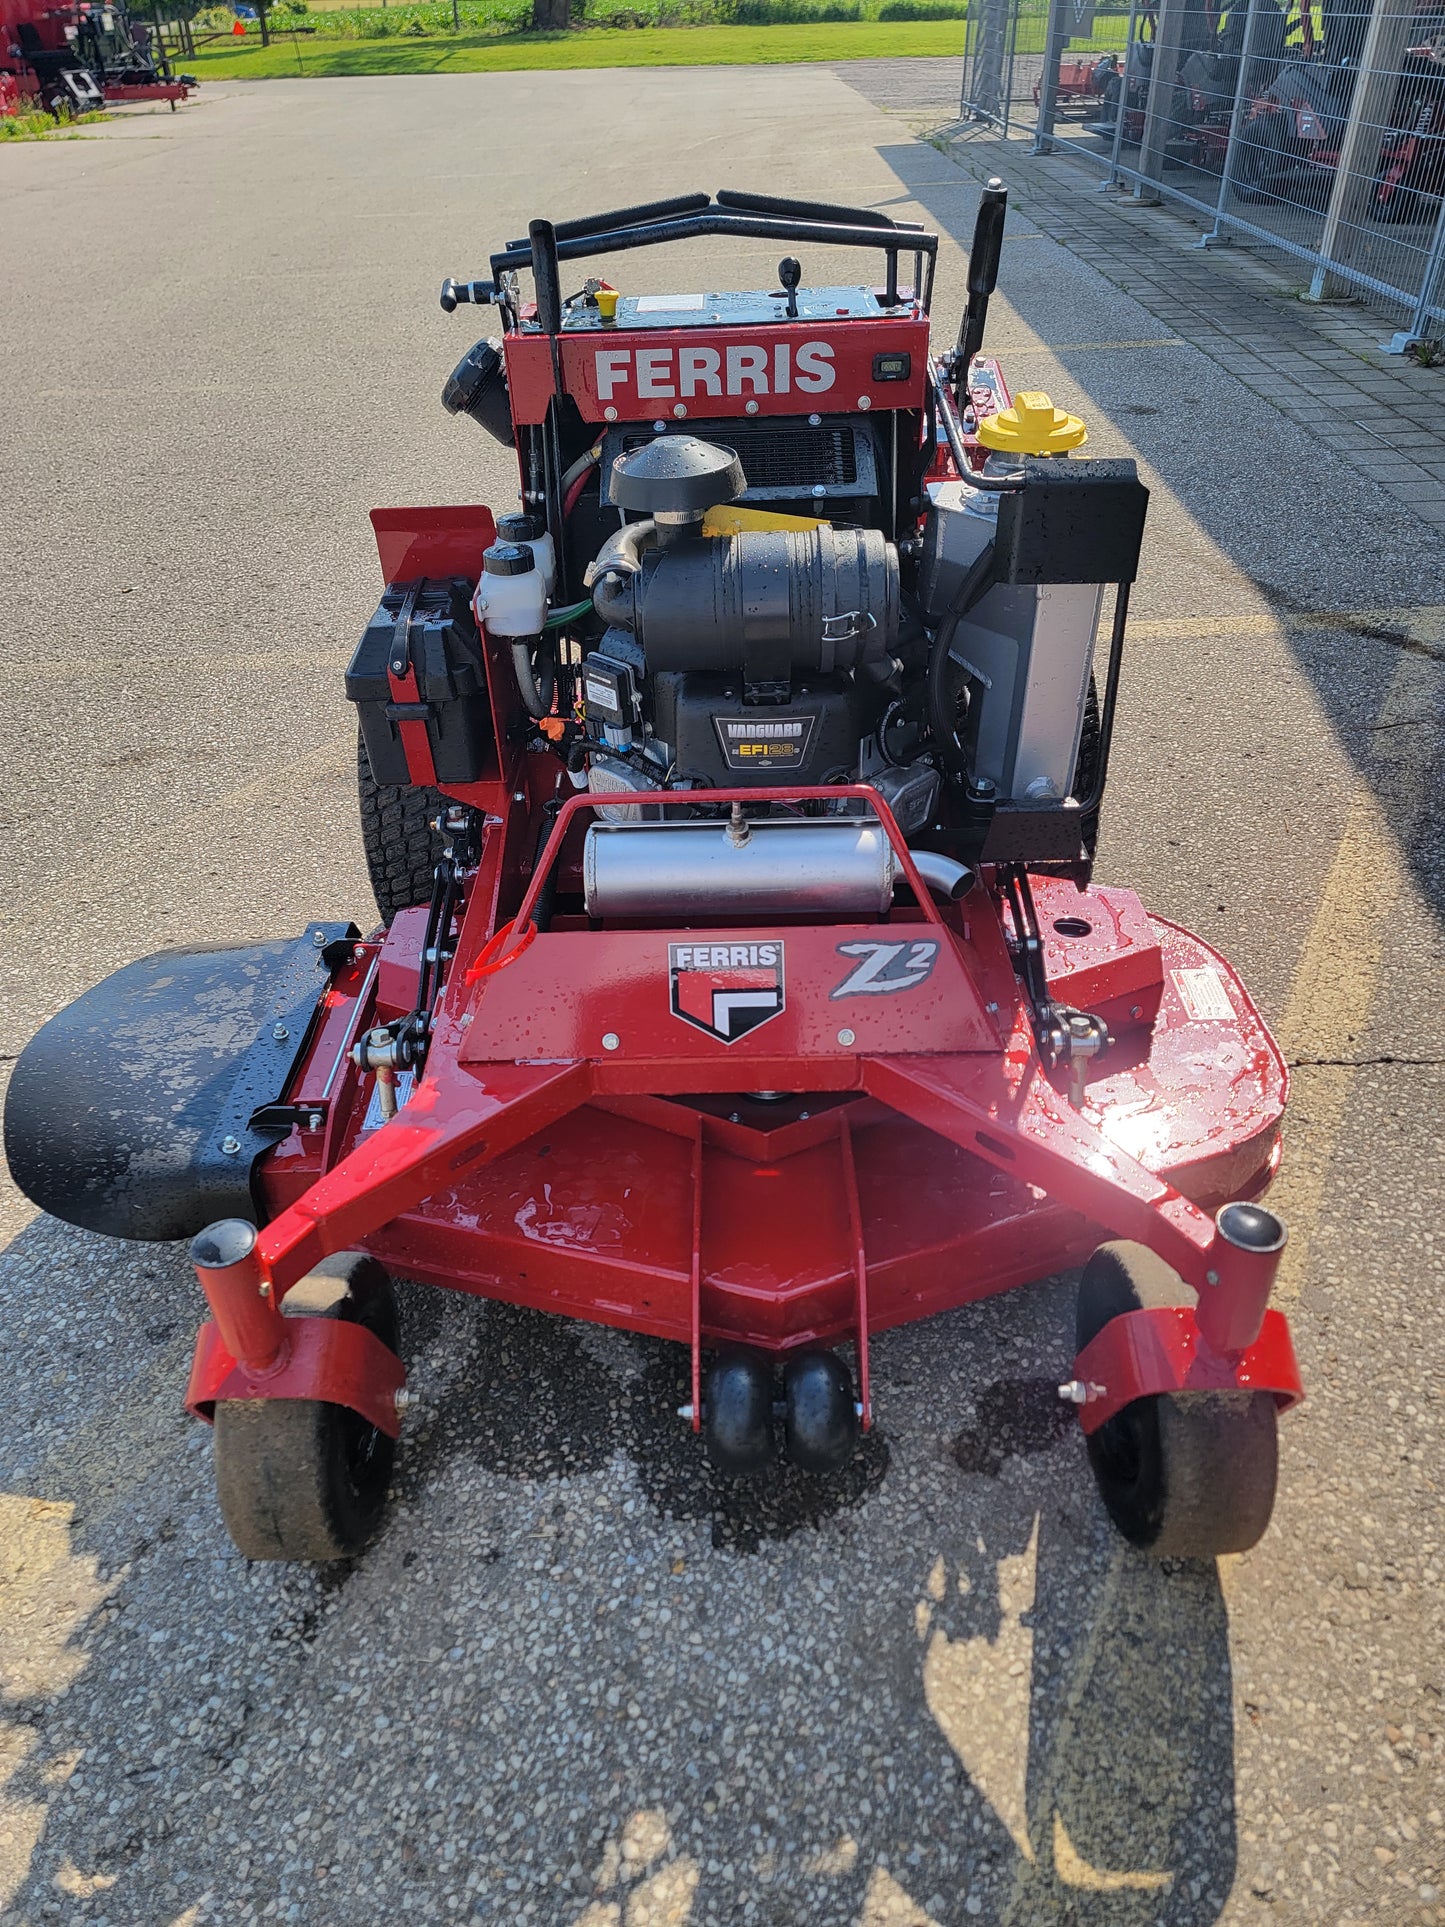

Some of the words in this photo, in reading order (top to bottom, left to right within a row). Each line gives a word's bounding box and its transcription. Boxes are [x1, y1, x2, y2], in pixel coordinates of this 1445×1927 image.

[594, 341, 836, 400] FERRIS
[727, 722, 803, 738] VANGUARD
[676, 945, 777, 967] FERRIS
